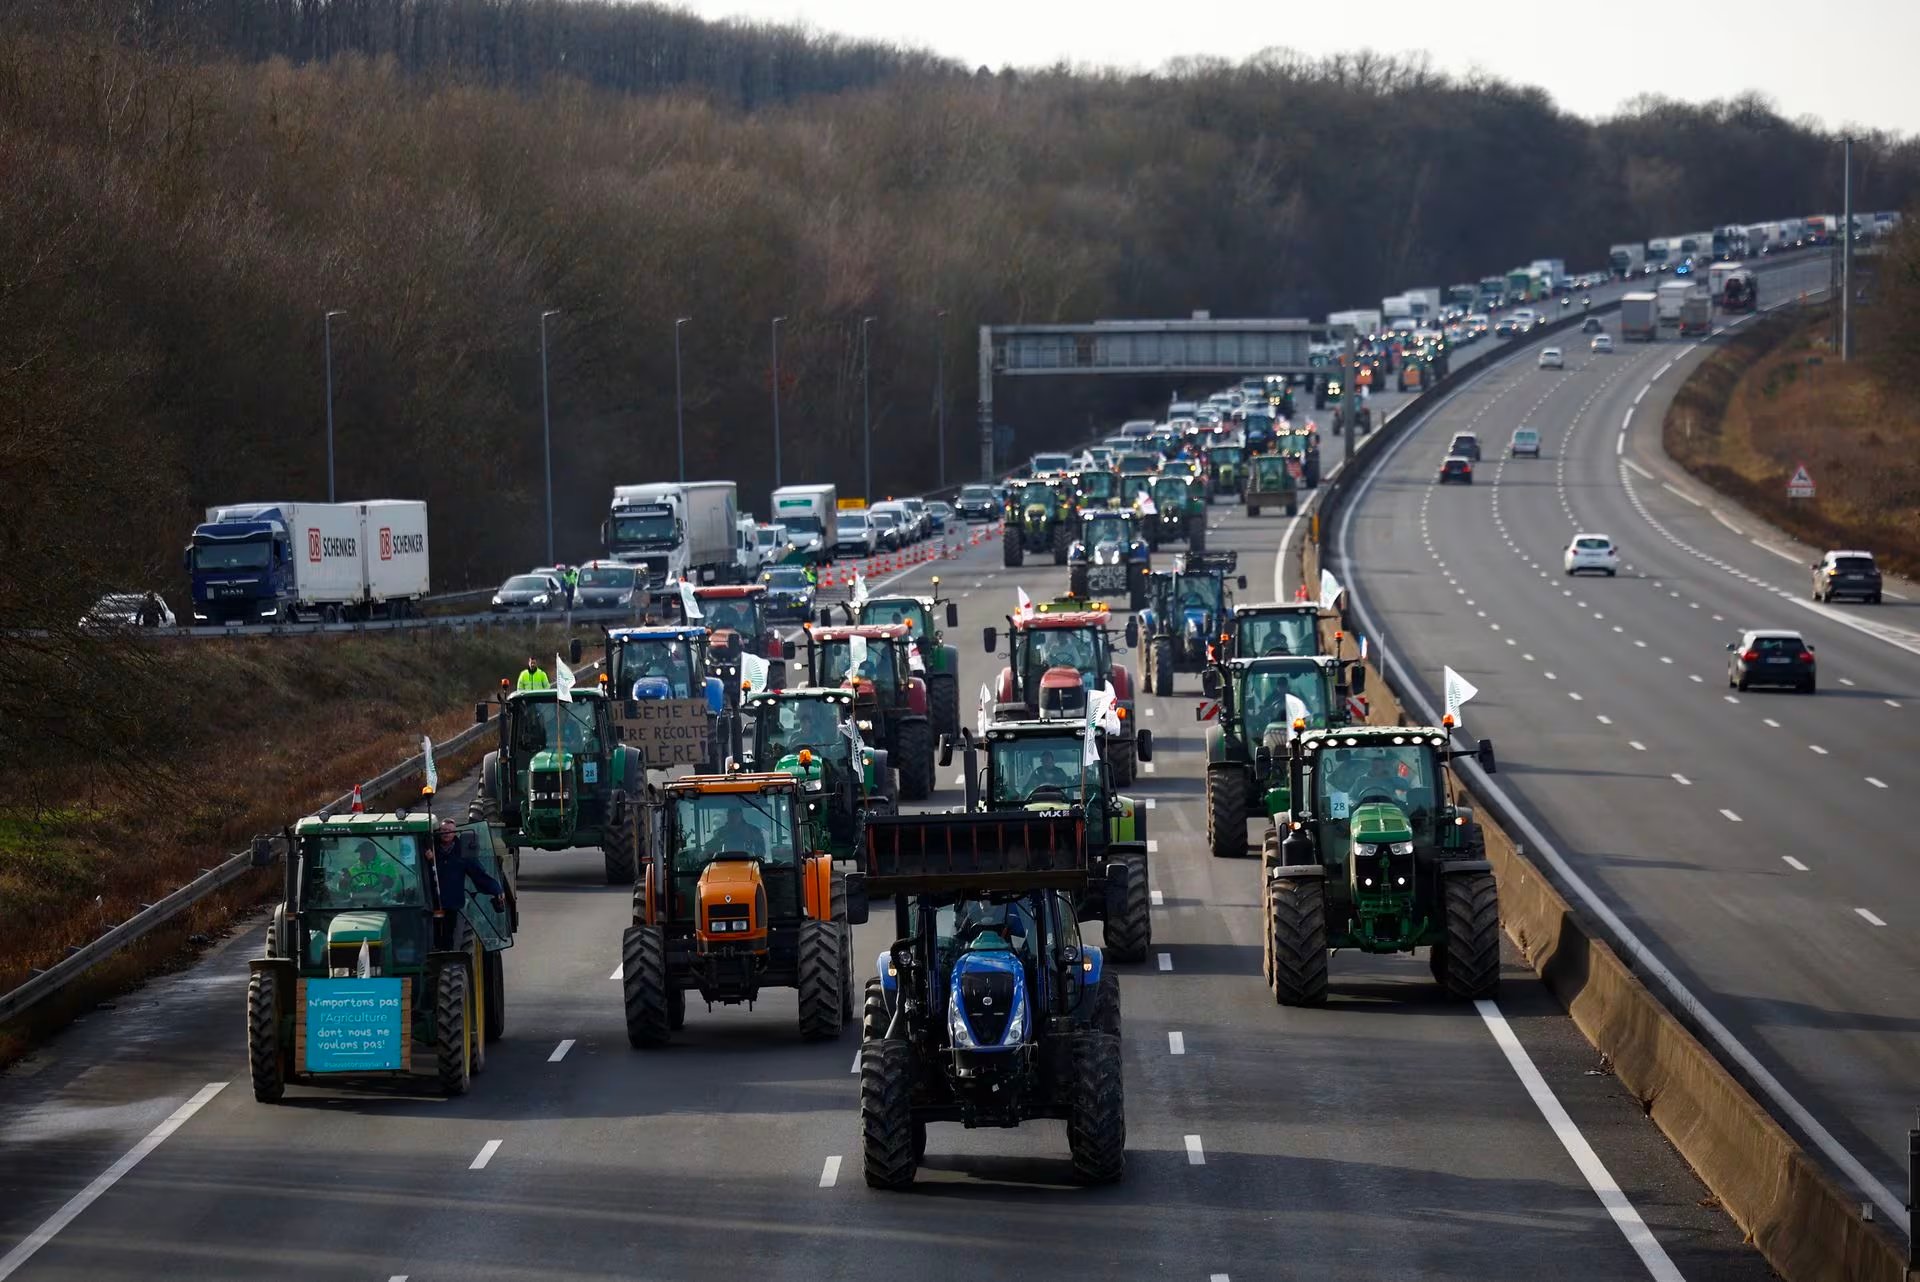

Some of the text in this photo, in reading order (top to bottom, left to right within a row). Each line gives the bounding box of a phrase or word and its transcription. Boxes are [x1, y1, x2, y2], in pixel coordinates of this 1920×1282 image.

[308, 529, 357, 562] DB SCHENKER
[380, 528, 424, 561] DB SCHENKER
[691, 703, 708, 717] LA
[654, 720, 708, 740] RÉCOLTE
[1333, 802, 1345, 811] 28
[1039, 810, 1062, 818] MX
[309, 998, 399, 1009] N'importons pas
[320, 1012, 388, 1025] l'Agriculture
[317, 1027, 390, 1038] dont nous ne
[317, 1039, 386, 1051] voulons pas!
